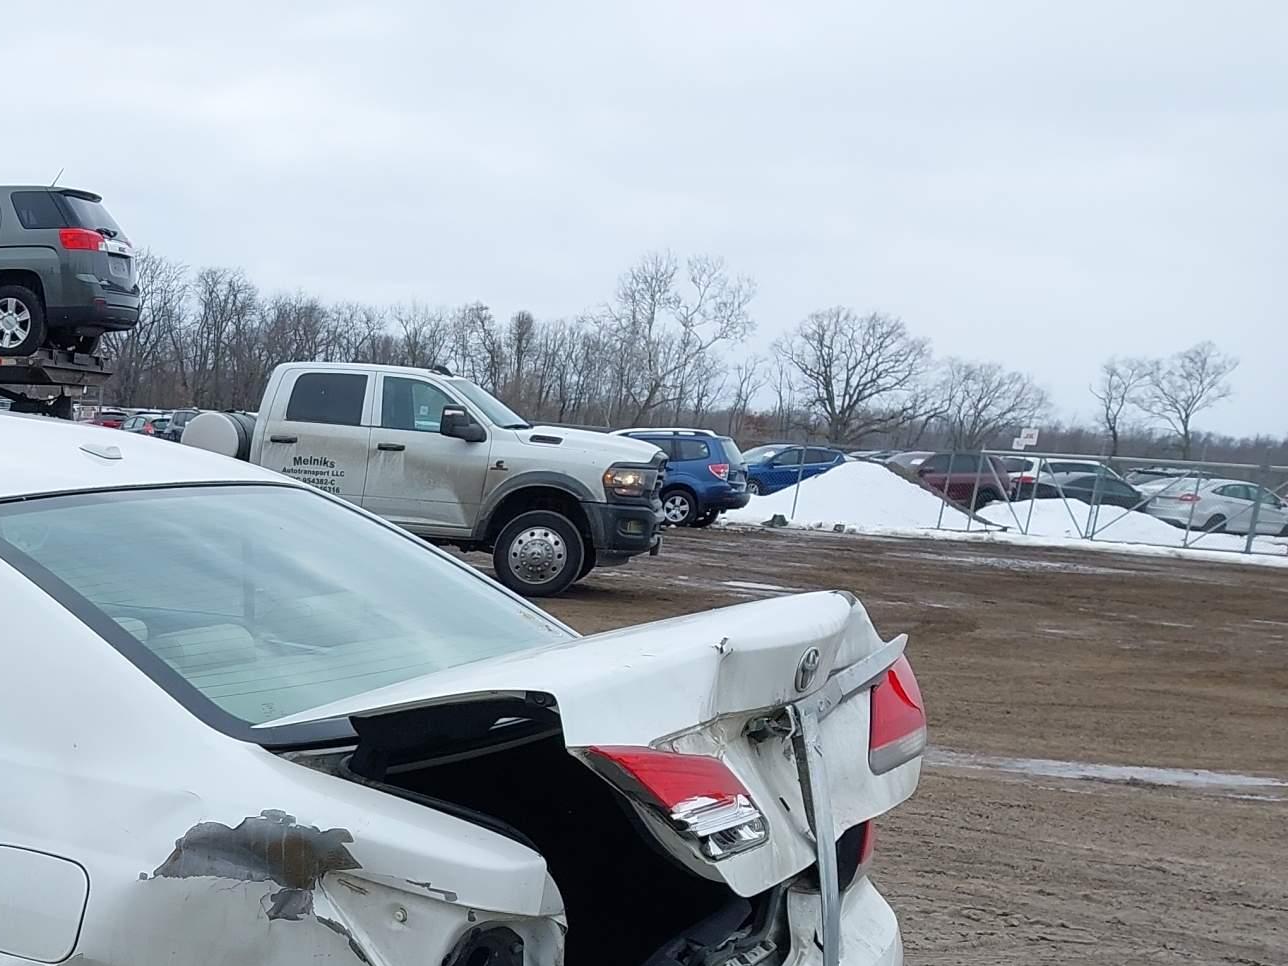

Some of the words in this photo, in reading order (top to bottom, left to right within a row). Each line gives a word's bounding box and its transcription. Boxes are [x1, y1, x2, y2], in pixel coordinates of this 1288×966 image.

[293, 455, 336, 469] Melniks
[282, 466, 330, 477] Autotransport
[331, 470, 345, 478] LLC
